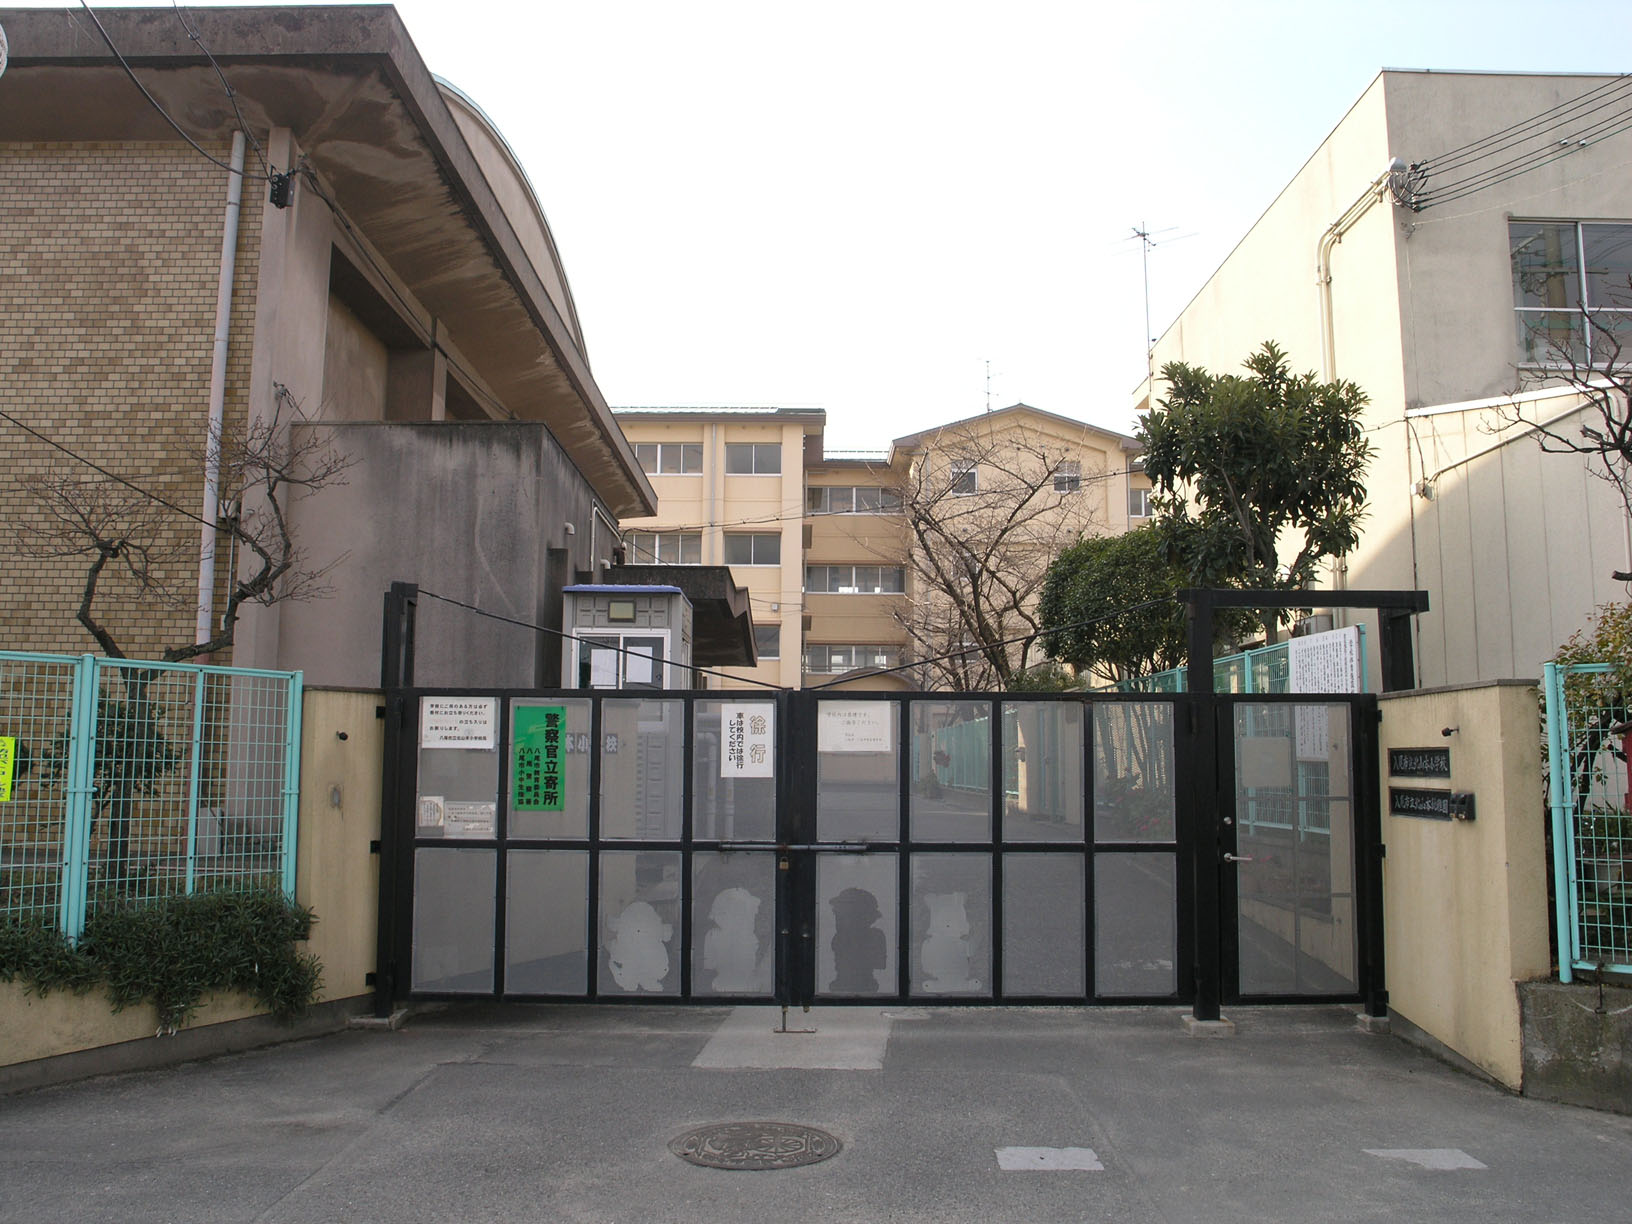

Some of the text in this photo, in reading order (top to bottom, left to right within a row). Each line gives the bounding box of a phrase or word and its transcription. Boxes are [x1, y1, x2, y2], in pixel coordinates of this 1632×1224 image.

[543, 713, 560, 806] 警察官立寄所
[728, 719, 737, 762] してください
[736, 712, 745, 769] 車は校内では徐行
[749, 714, 767, 764] 徐行
